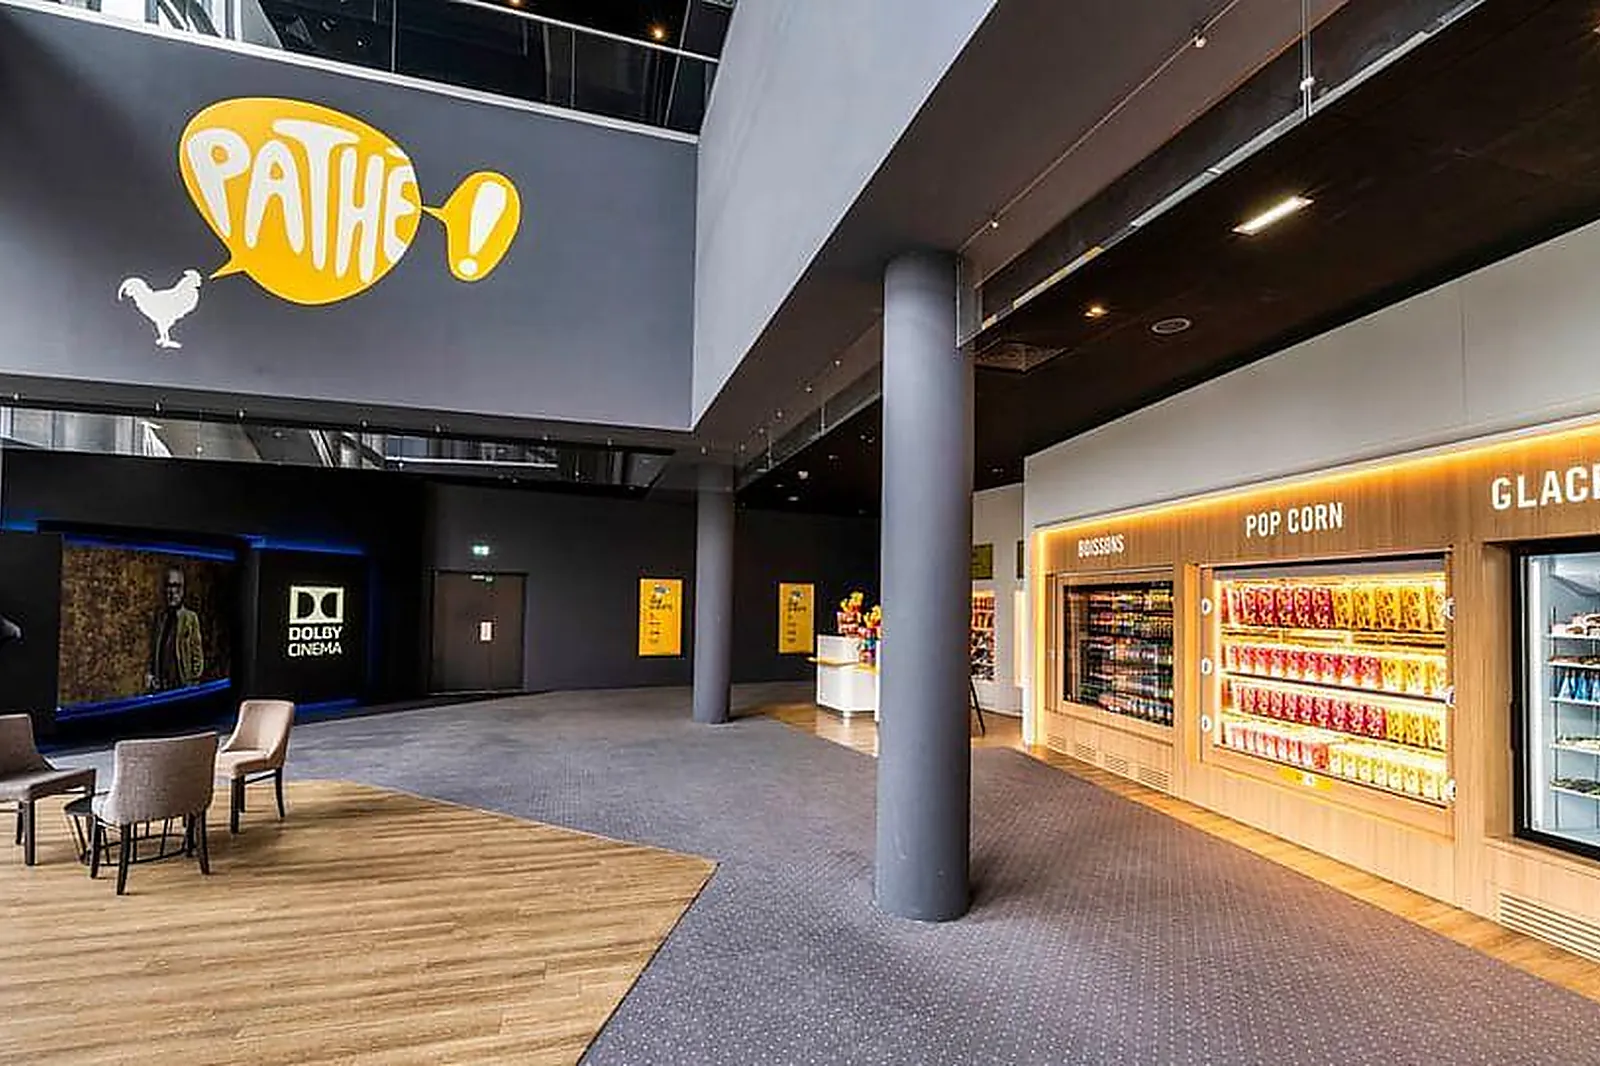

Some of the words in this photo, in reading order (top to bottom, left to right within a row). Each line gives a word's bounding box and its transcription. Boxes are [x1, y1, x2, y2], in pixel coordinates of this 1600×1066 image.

[1246, 511, 1281, 539] POP
[1287, 502, 1343, 534] CORN
[1078, 533, 1125, 558] BOISSONS
[288, 626, 344, 641] DOLBY
[287, 641, 343, 657] CINEMA
